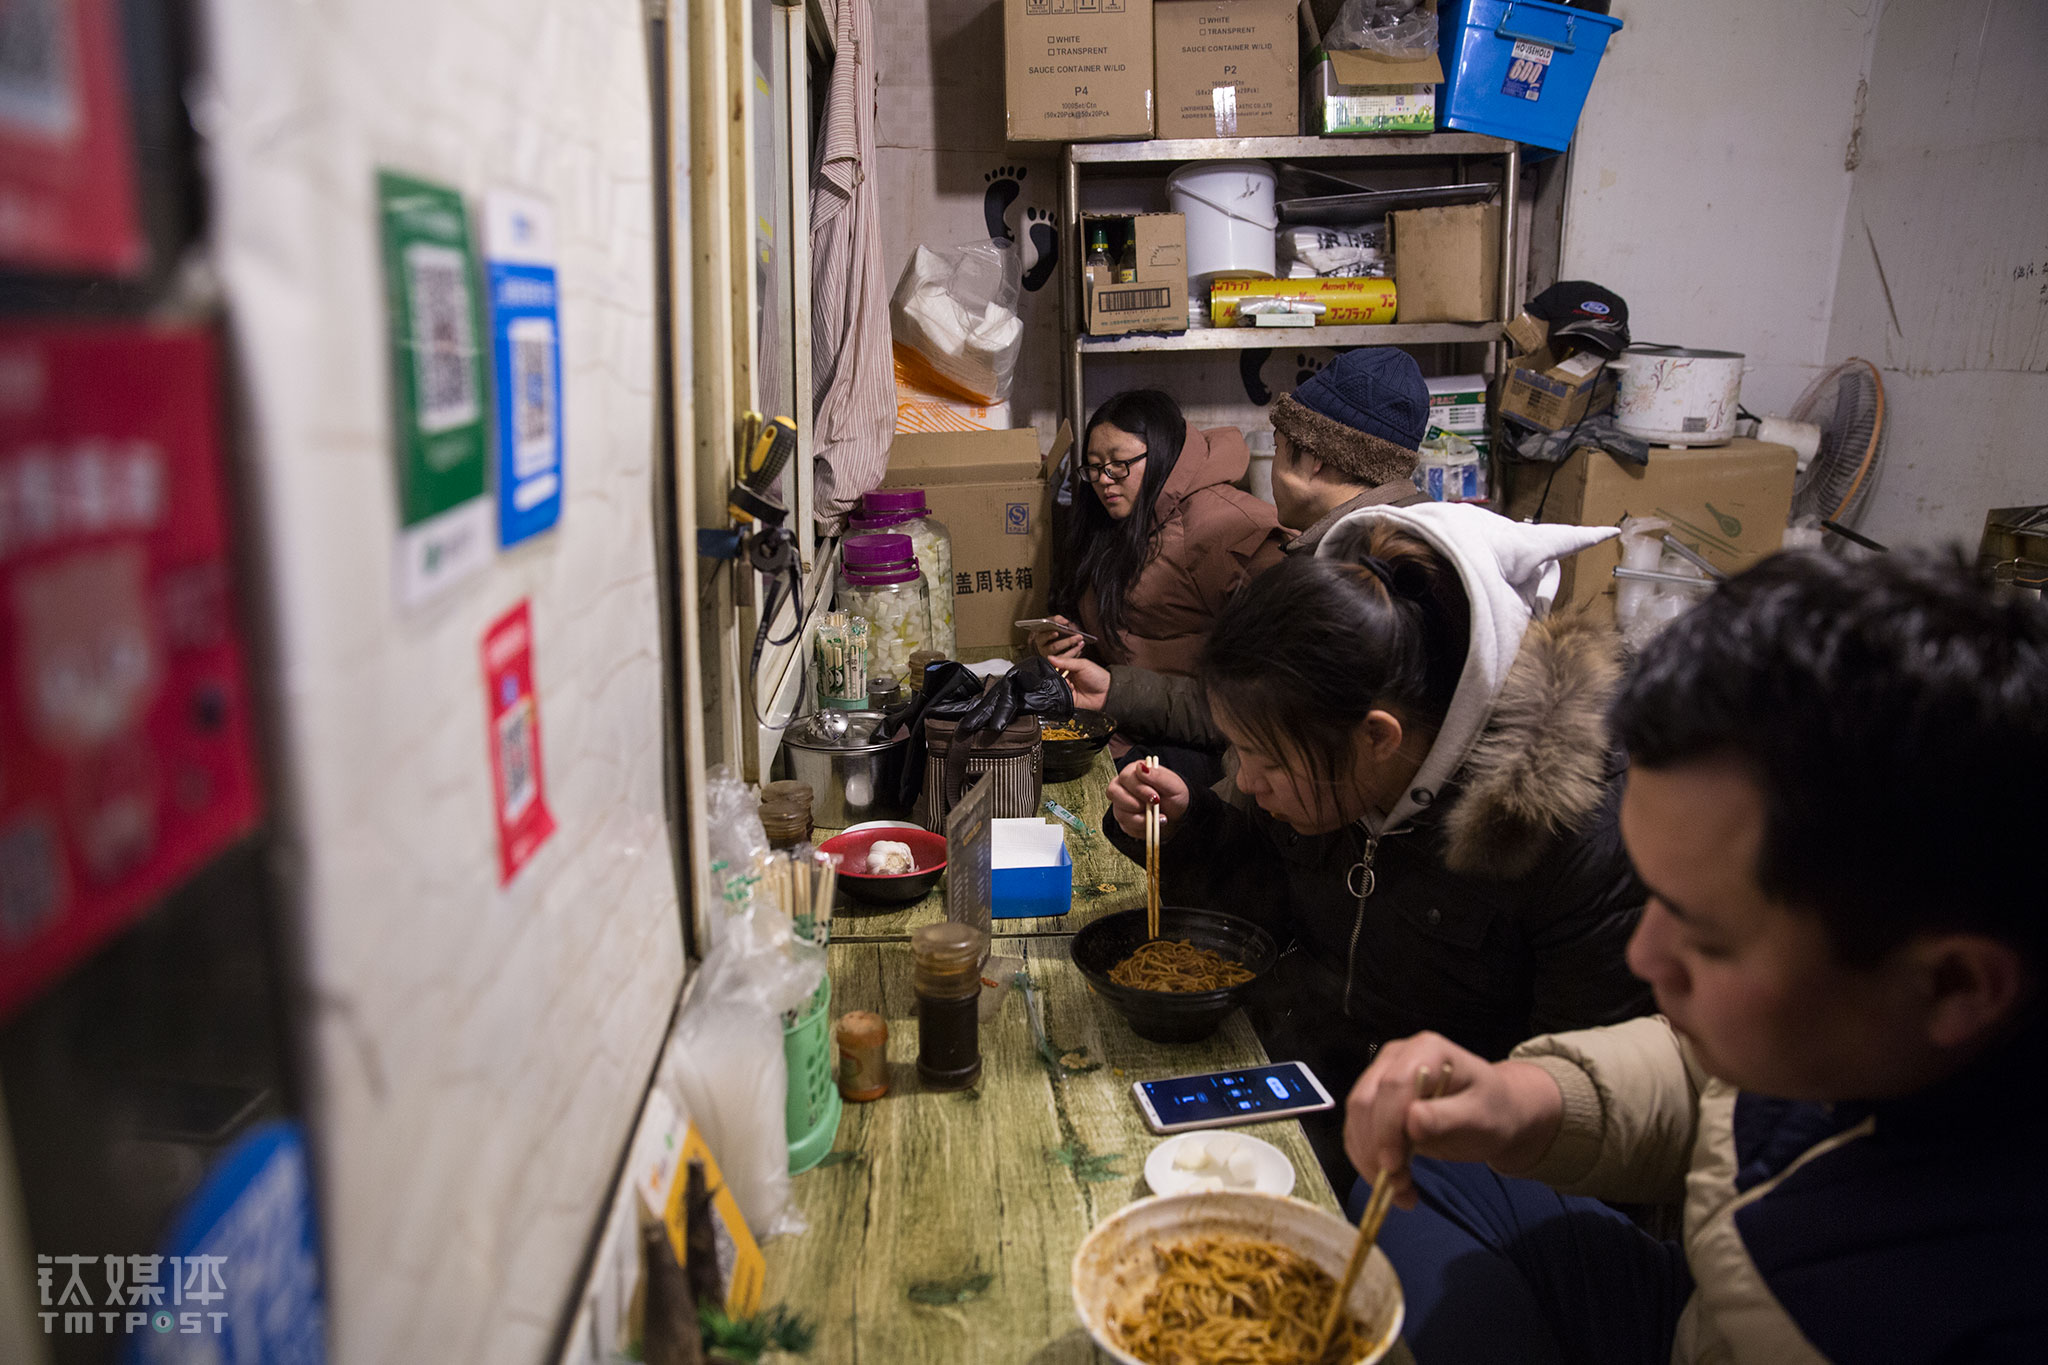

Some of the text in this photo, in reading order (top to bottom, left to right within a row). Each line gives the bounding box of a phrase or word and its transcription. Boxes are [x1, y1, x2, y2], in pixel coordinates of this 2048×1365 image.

[1207, 16, 1230, 24] WHITE
[1207, 27, 1256, 35] TRANSPRENT
[1055, 35, 1081, 43] WHITE
[1056, 46, 1108, 56] TRANSPRENT
[1207, 44, 1249, 52] CONTAINER
[1028, 63, 1126, 74] SAUCE CONTAINER W/LID
[1224, 65, 1237, 75] P2
[1074, 86, 1089, 96] P4
[955, 566, 1033, 595] 盖周转箱
